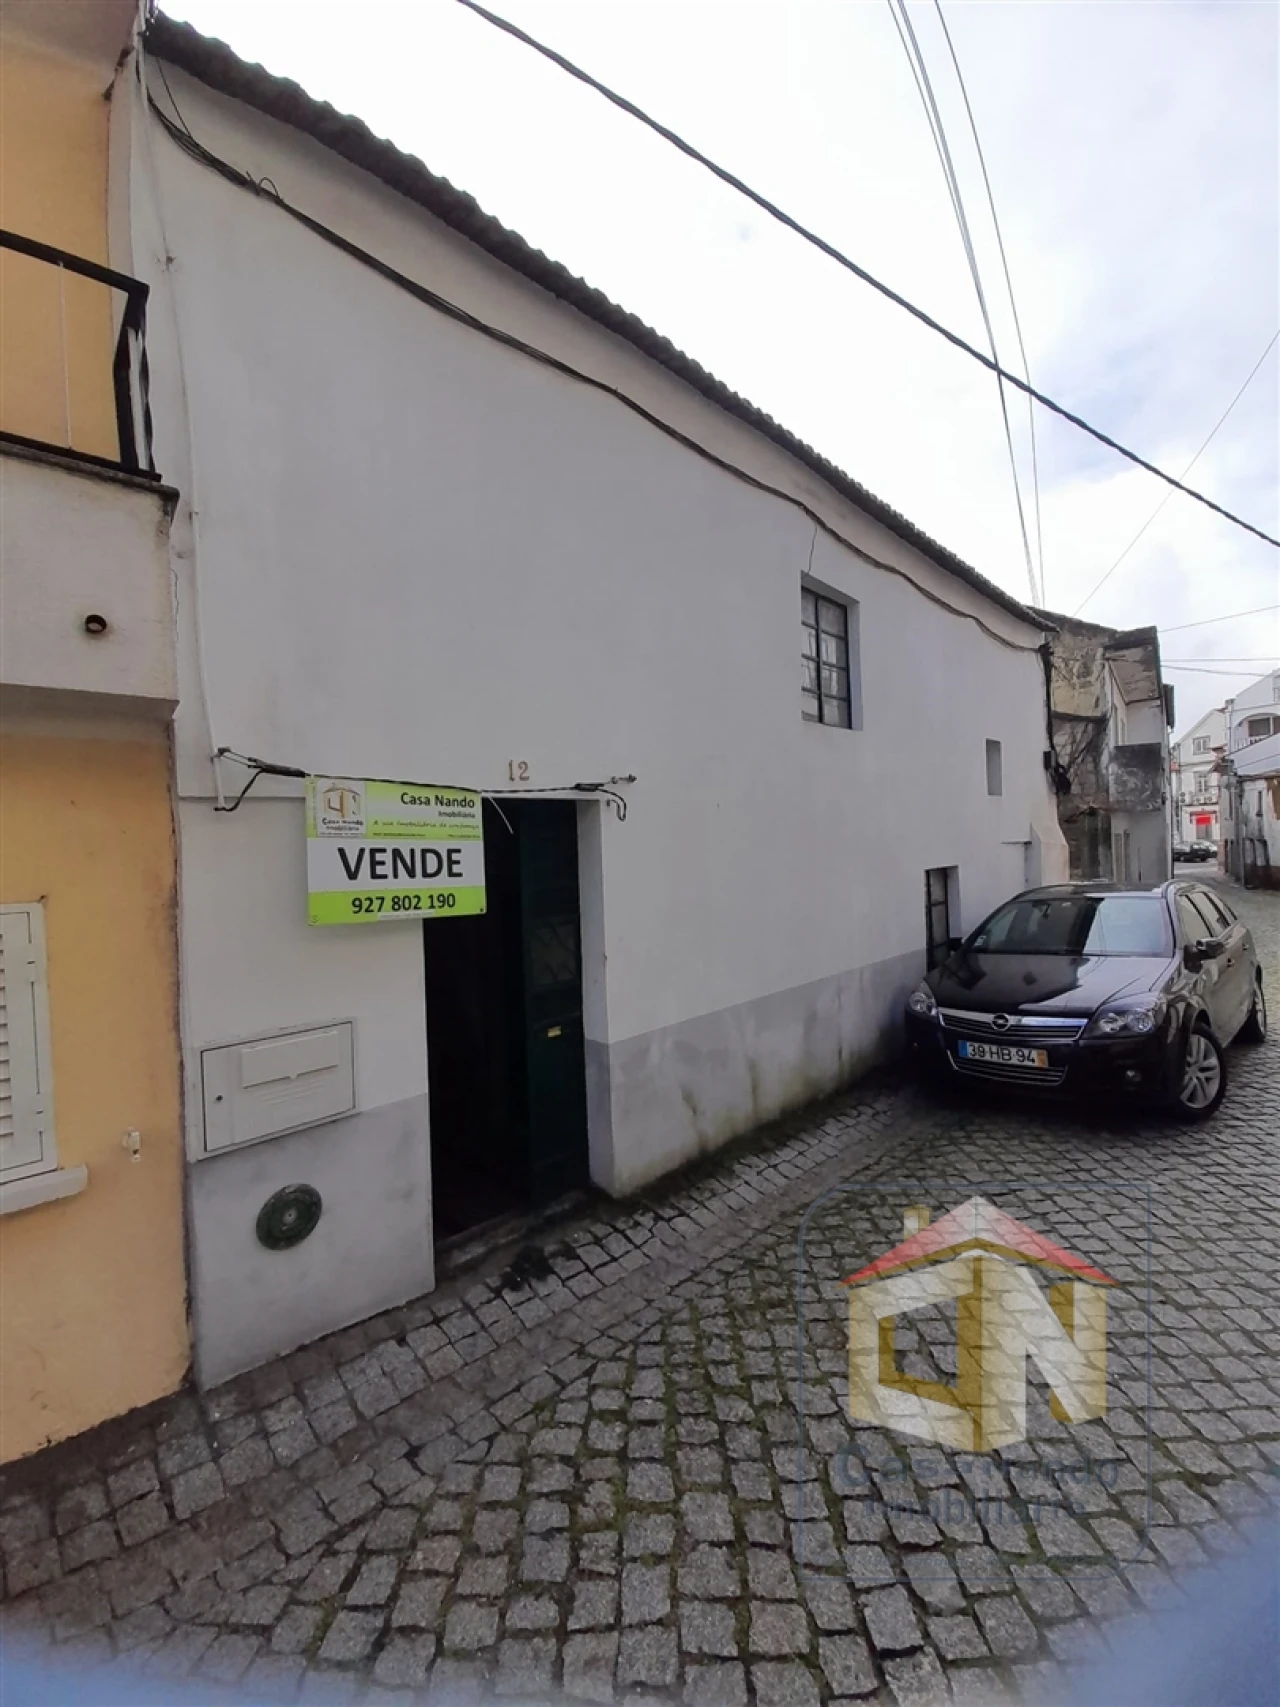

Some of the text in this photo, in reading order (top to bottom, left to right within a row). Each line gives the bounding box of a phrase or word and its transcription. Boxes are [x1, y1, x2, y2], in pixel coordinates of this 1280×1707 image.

[508, 759, 530, 781] 12
[401, 792, 475, 808] Casa Nando
[337, 847, 463, 880] VENDE
[351, 893, 456, 914] 927 802 190
